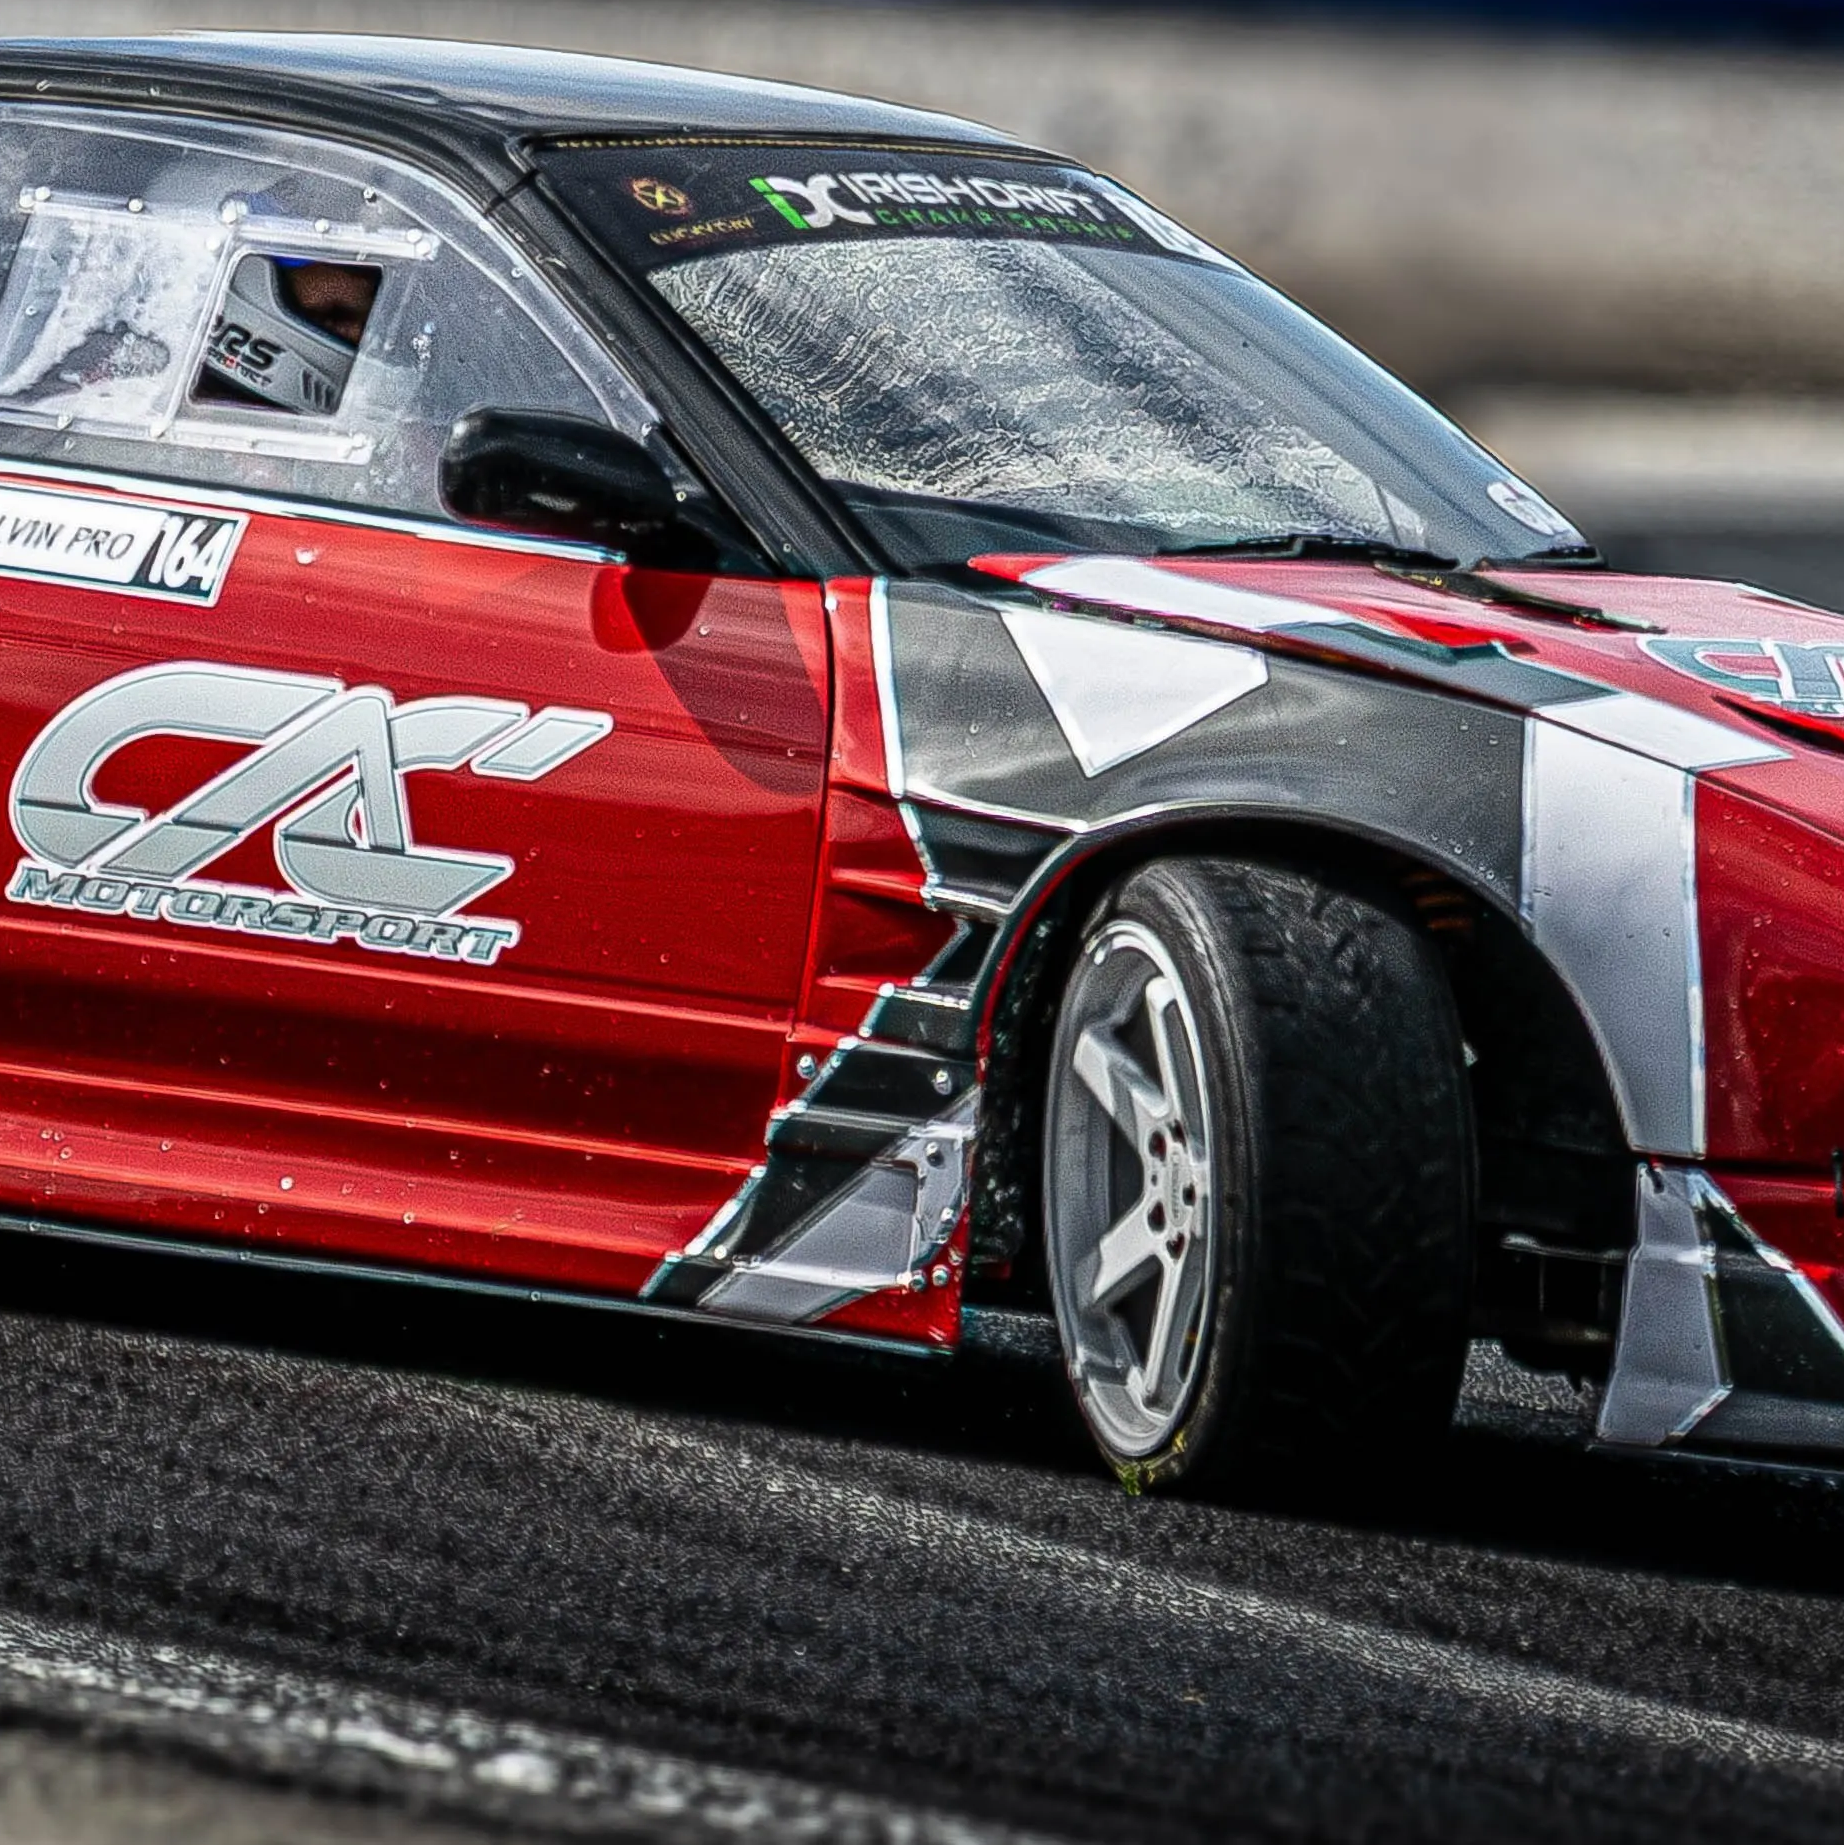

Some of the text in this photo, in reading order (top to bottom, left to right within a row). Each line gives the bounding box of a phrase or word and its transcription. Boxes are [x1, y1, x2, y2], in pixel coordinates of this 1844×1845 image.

[65, 526, 135, 561] PRO
[148, 513, 236, 593] 164
[7, 859, 519, 963] MOTORSPORT
